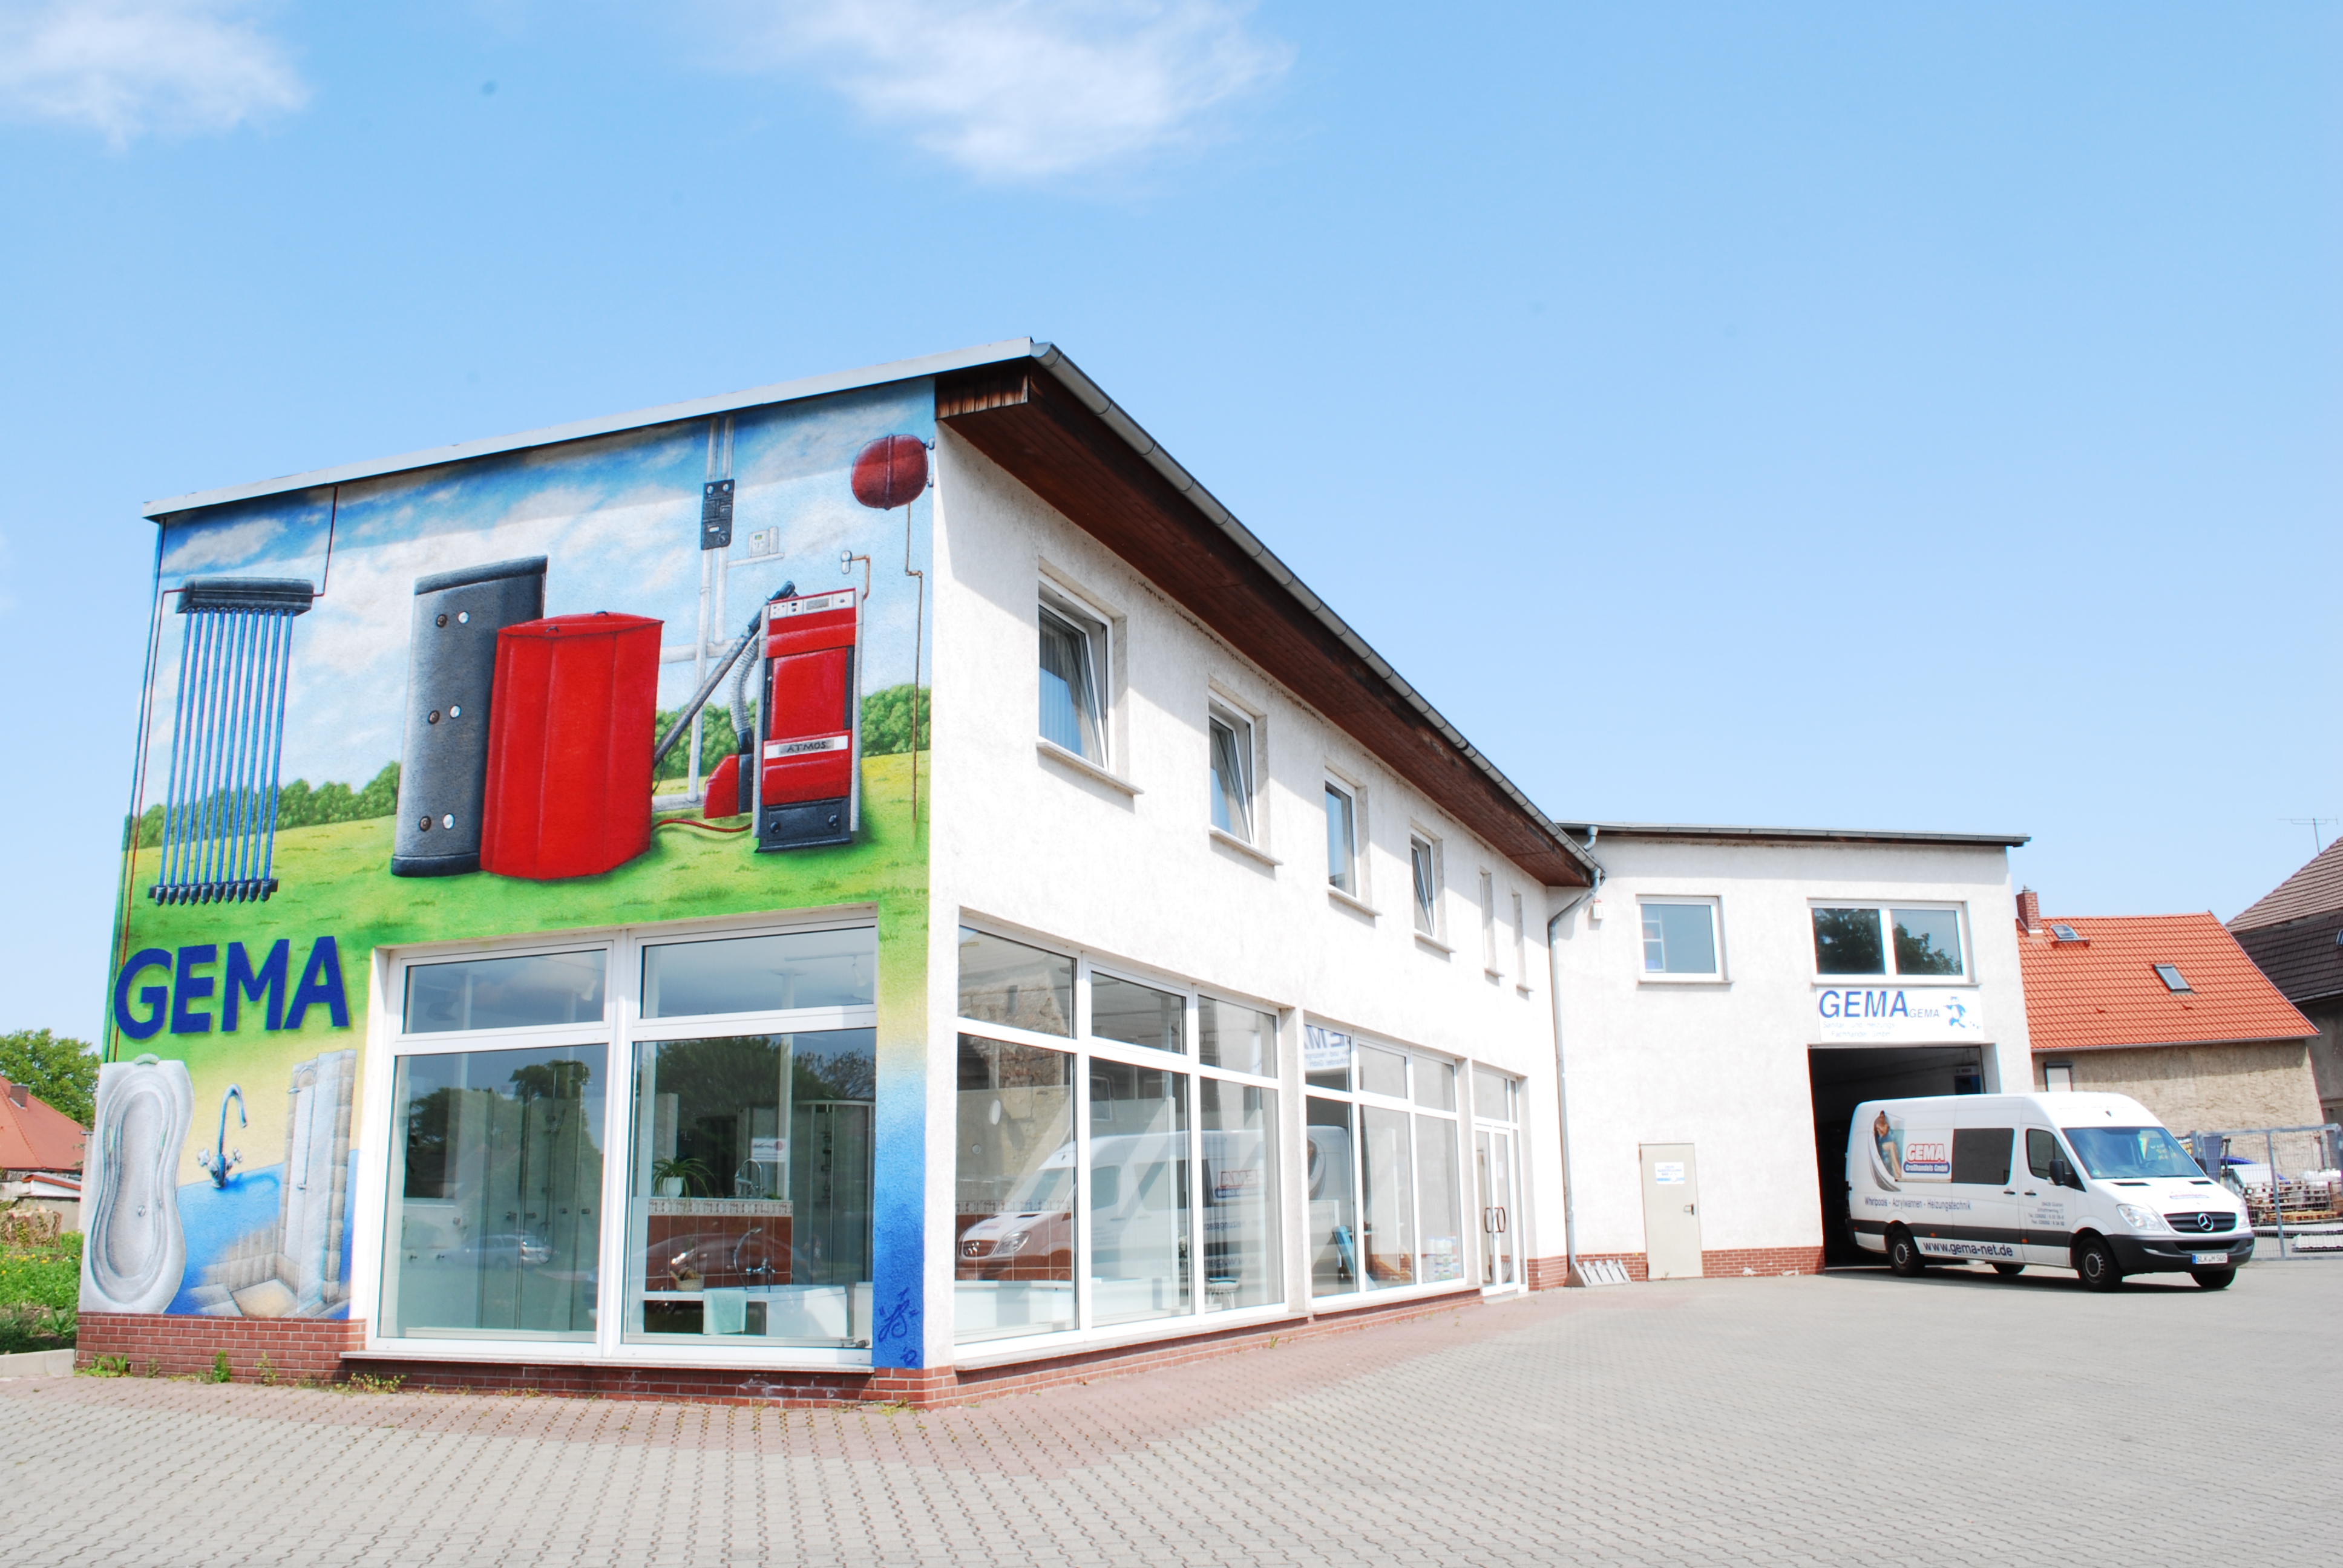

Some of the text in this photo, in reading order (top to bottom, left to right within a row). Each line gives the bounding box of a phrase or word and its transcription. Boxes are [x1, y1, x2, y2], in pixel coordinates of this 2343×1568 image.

[786, 740, 827, 754] ATMOS
[114, 935, 350, 1040] GEMA
[1818, 990, 1909, 1019] GEMA
[1909, 1008, 1940, 1019] GEMA
[1906, 1143, 1945, 1162] GEMA
[1927, 1198, 1971, 1211] Heizungstechnik
[1922, 1241, 2014, 1257] www.gema-net.de
